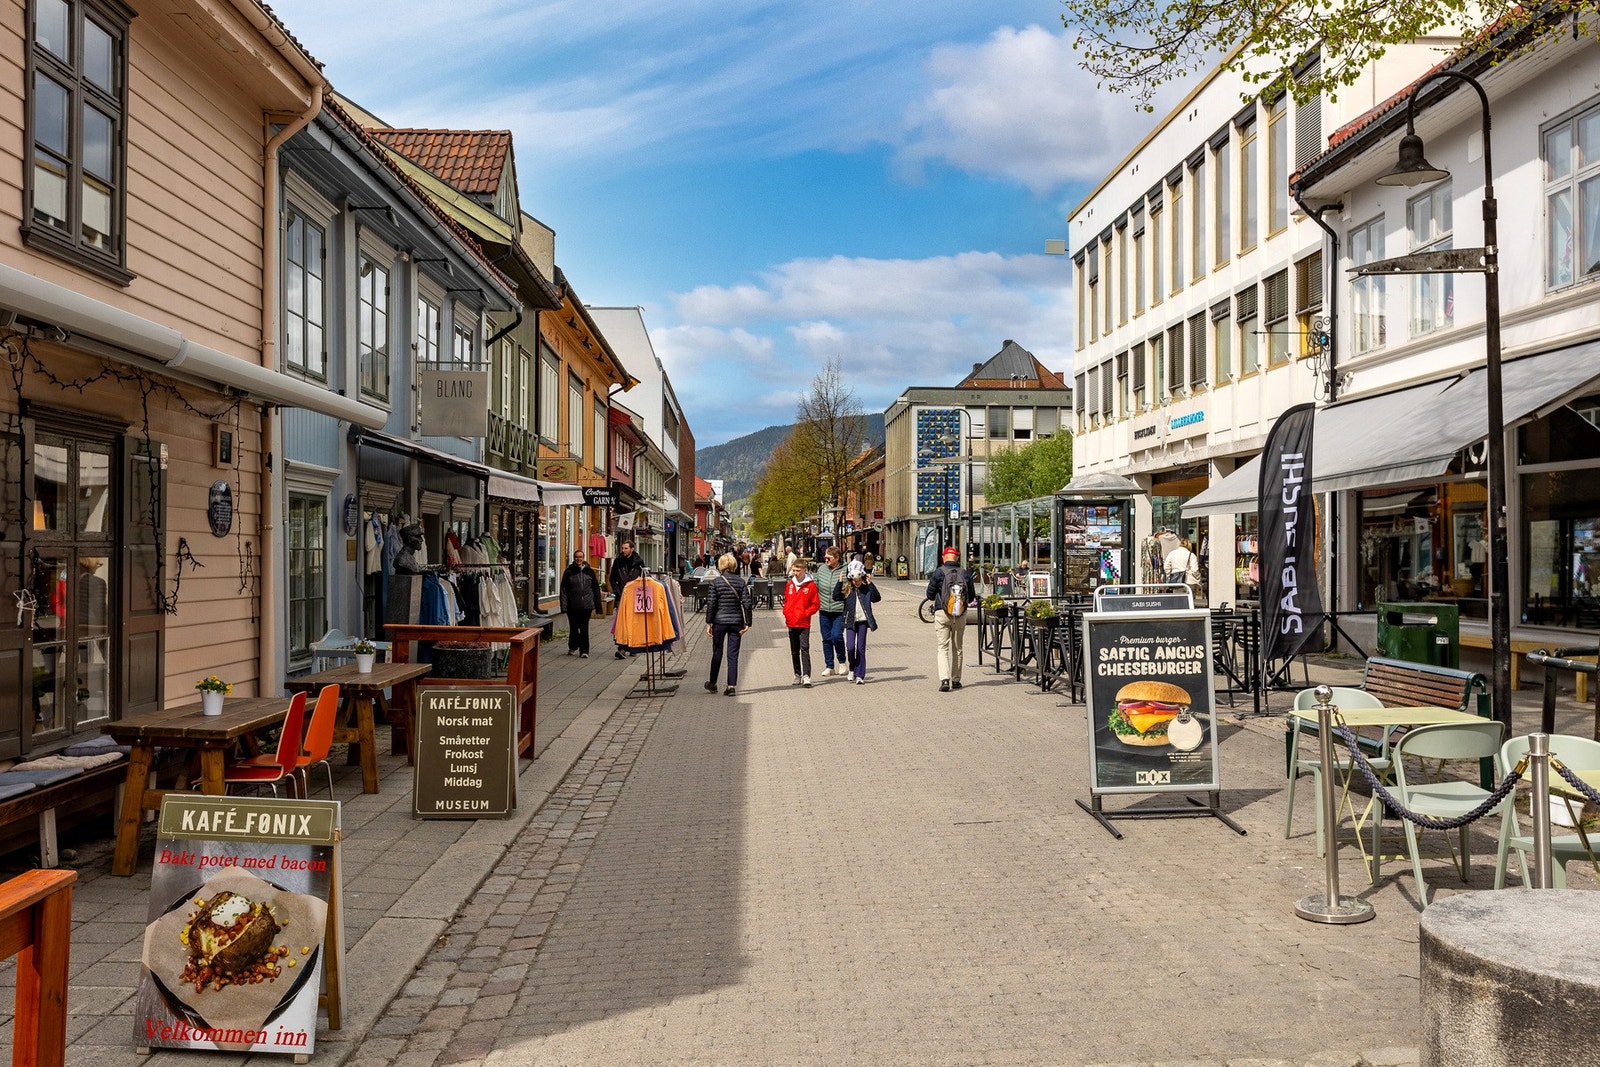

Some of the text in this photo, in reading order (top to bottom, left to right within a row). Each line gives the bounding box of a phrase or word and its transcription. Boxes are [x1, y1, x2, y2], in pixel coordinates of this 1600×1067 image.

[437, 379, 473, 398] BLANC
[593, 496, 610, 505] GARN
[1119, 635, 1181, 646] Premium burger
[1099, 645, 1205, 661] SAFTIG ANGUS
[1097, 660, 1202, 676] CHEESEBURGER
[429, 695, 502, 710] KAFÉ FØNIX
[437, 716, 493, 726] Norsk mat
[439, 735, 490, 745] Småretter
[445, 749, 484, 759] Frokost
[450, 763, 478, 774] Lunsj
[444, 777, 483, 788] Middag
[435, 800, 489, 810] MUSEUM
[181, 807, 313, 836] KAFÉ FØNIX
[158, 849, 327, 873] Bakt potet med bacon
[144, 1018, 308, 1047] Velkommen inn
